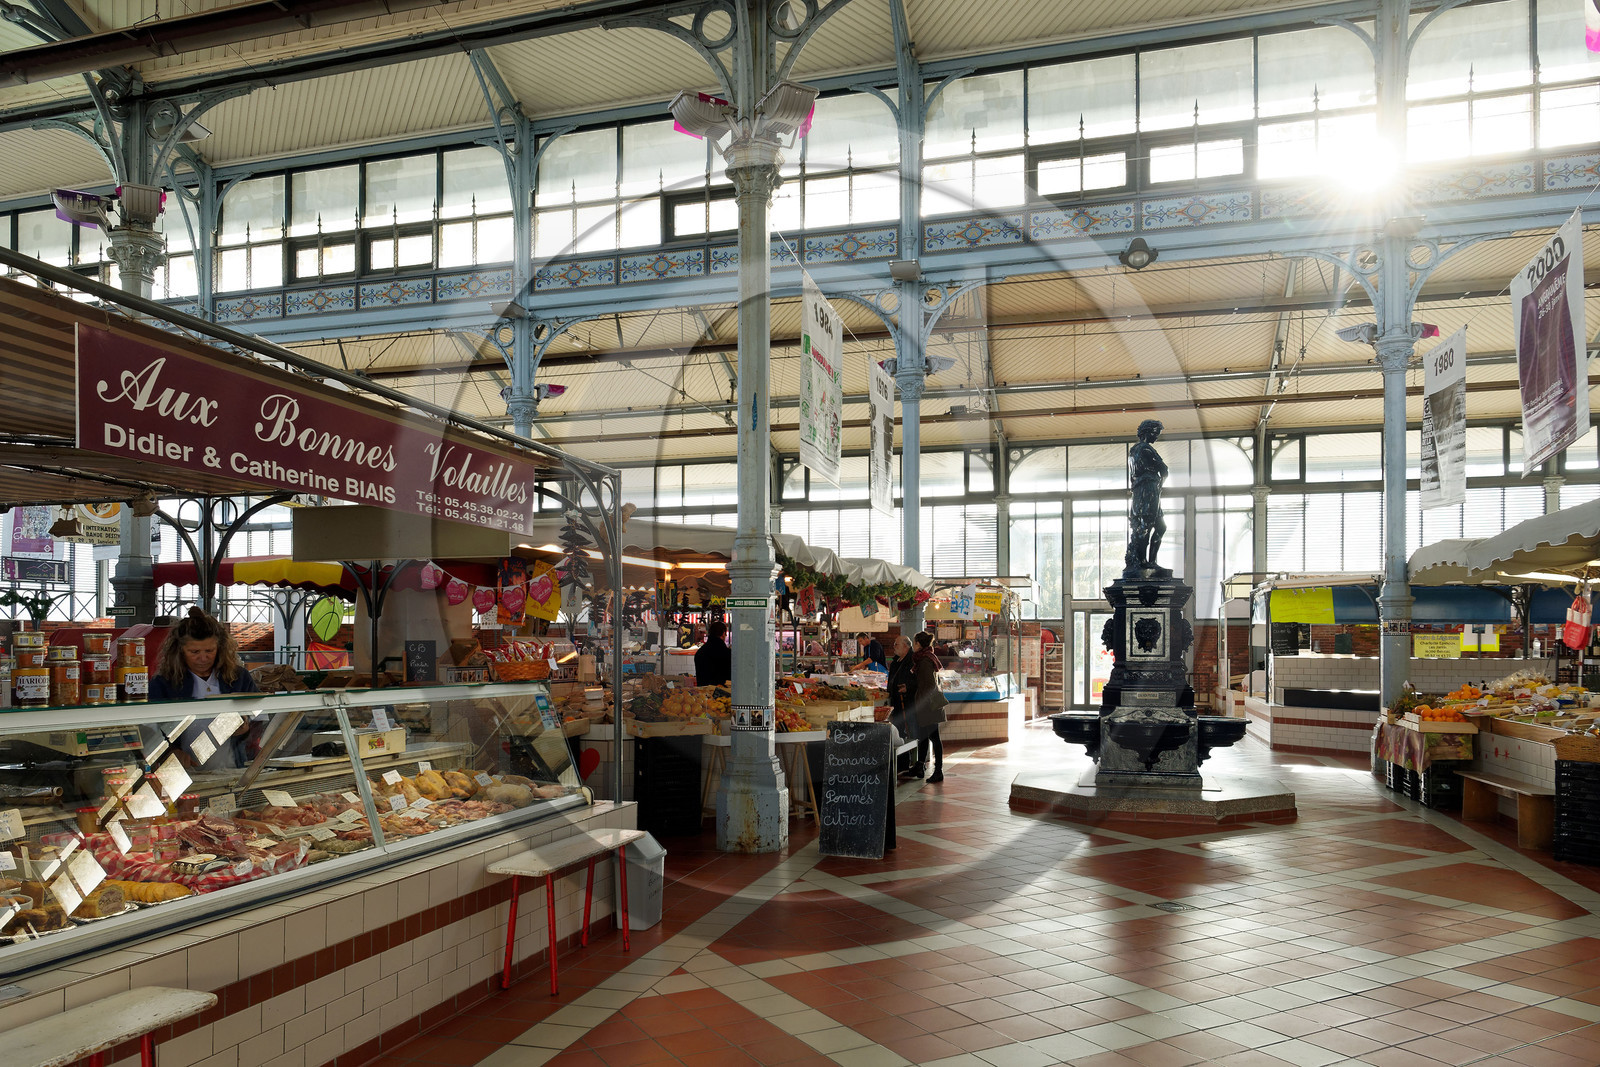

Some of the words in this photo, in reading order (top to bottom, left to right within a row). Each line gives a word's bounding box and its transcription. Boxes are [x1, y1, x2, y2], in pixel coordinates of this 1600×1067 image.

[1527, 236, 1565, 290] 2000
[813, 302, 834, 340] 1984
[1434, 347, 1454, 377] 1980
[876, 376, 889, 401] 1976
[96, 357, 219, 428] Aux
[254, 394, 398, 473] Bonnes
[424, 442, 528, 505] Volailles
[104, 422, 194, 462] Didier
[202, 446, 222, 469] &
[230, 452, 340, 493] Catherine
[345, 477, 397, 504] BIAIS
[416, 489, 441, 504] Tél:
[444, 496, 525, 522] 05.45.38.02.24
[416, 502, 441, 516] Tél:
[444, 508, 524, 532] 05.45.91.21.48
[834, 729, 866, 744] Bio
